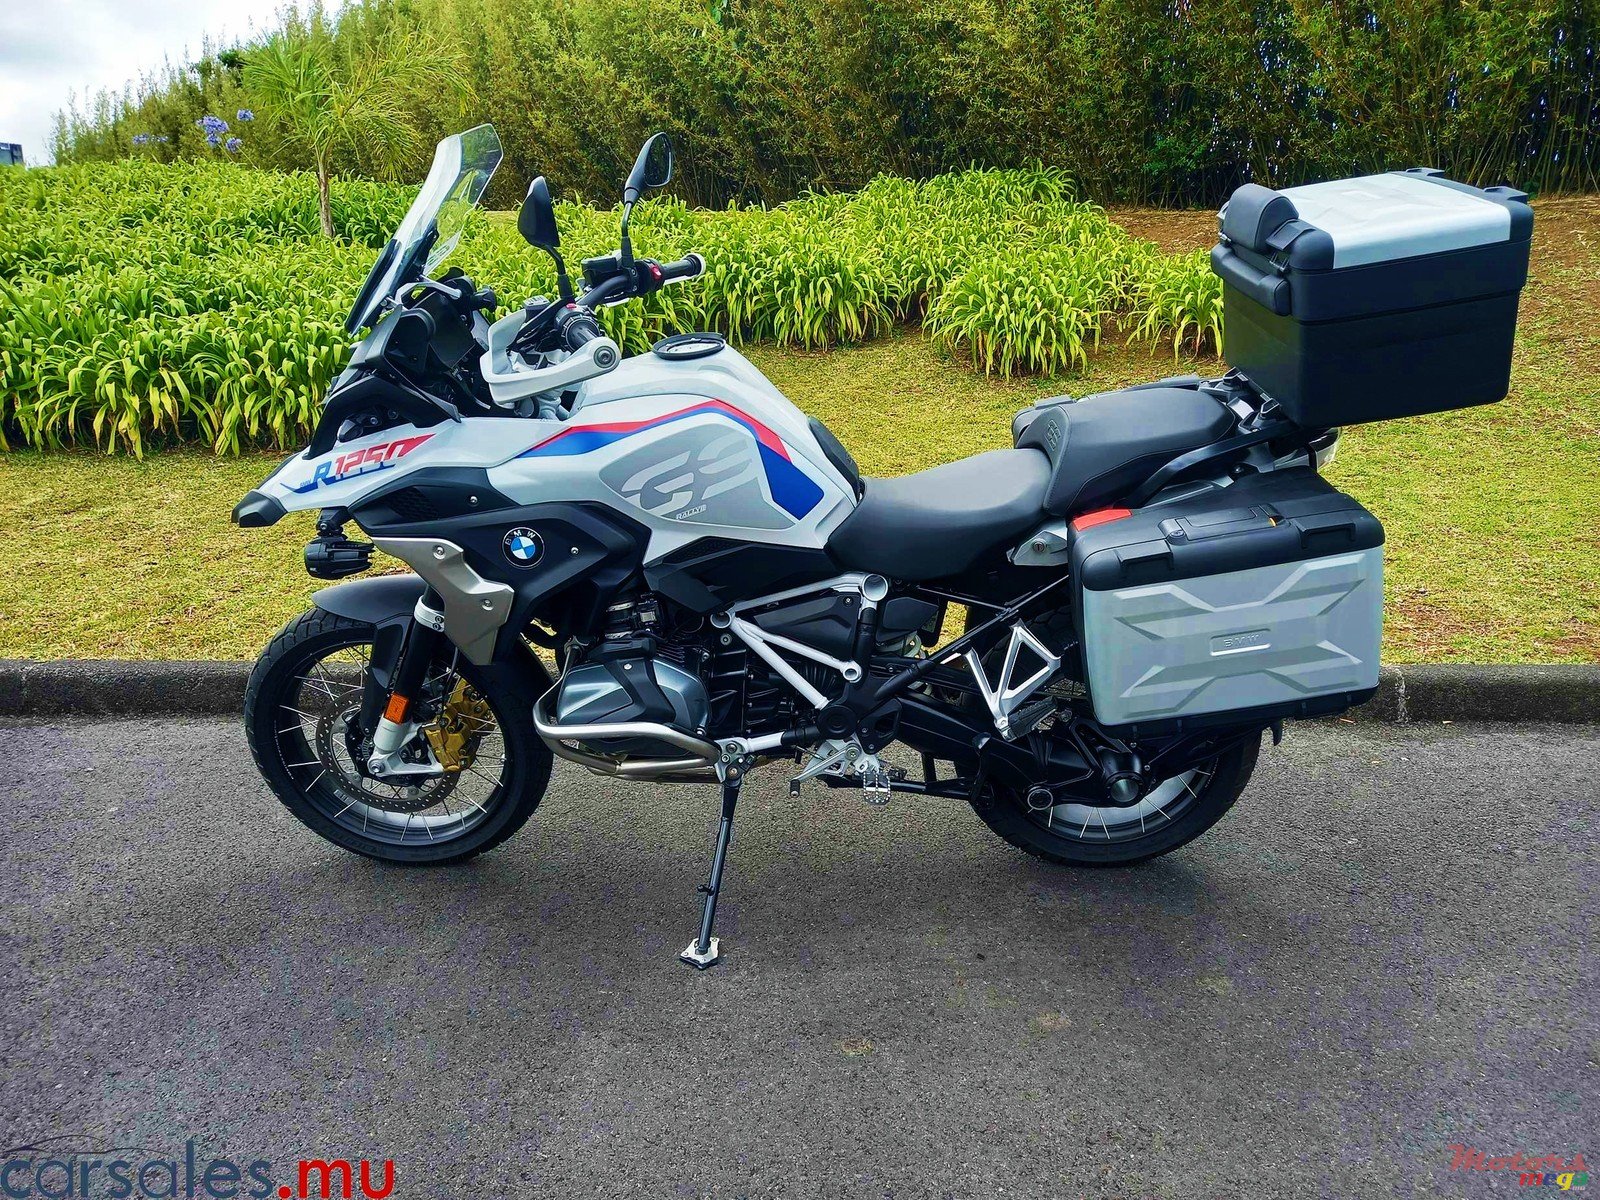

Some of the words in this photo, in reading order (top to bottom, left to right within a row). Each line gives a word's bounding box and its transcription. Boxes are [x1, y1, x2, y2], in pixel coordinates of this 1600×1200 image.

[621, 432, 756, 517] GS
[504, 529, 536, 546] BMW
[1223, 634, 1262, 647] BMW
